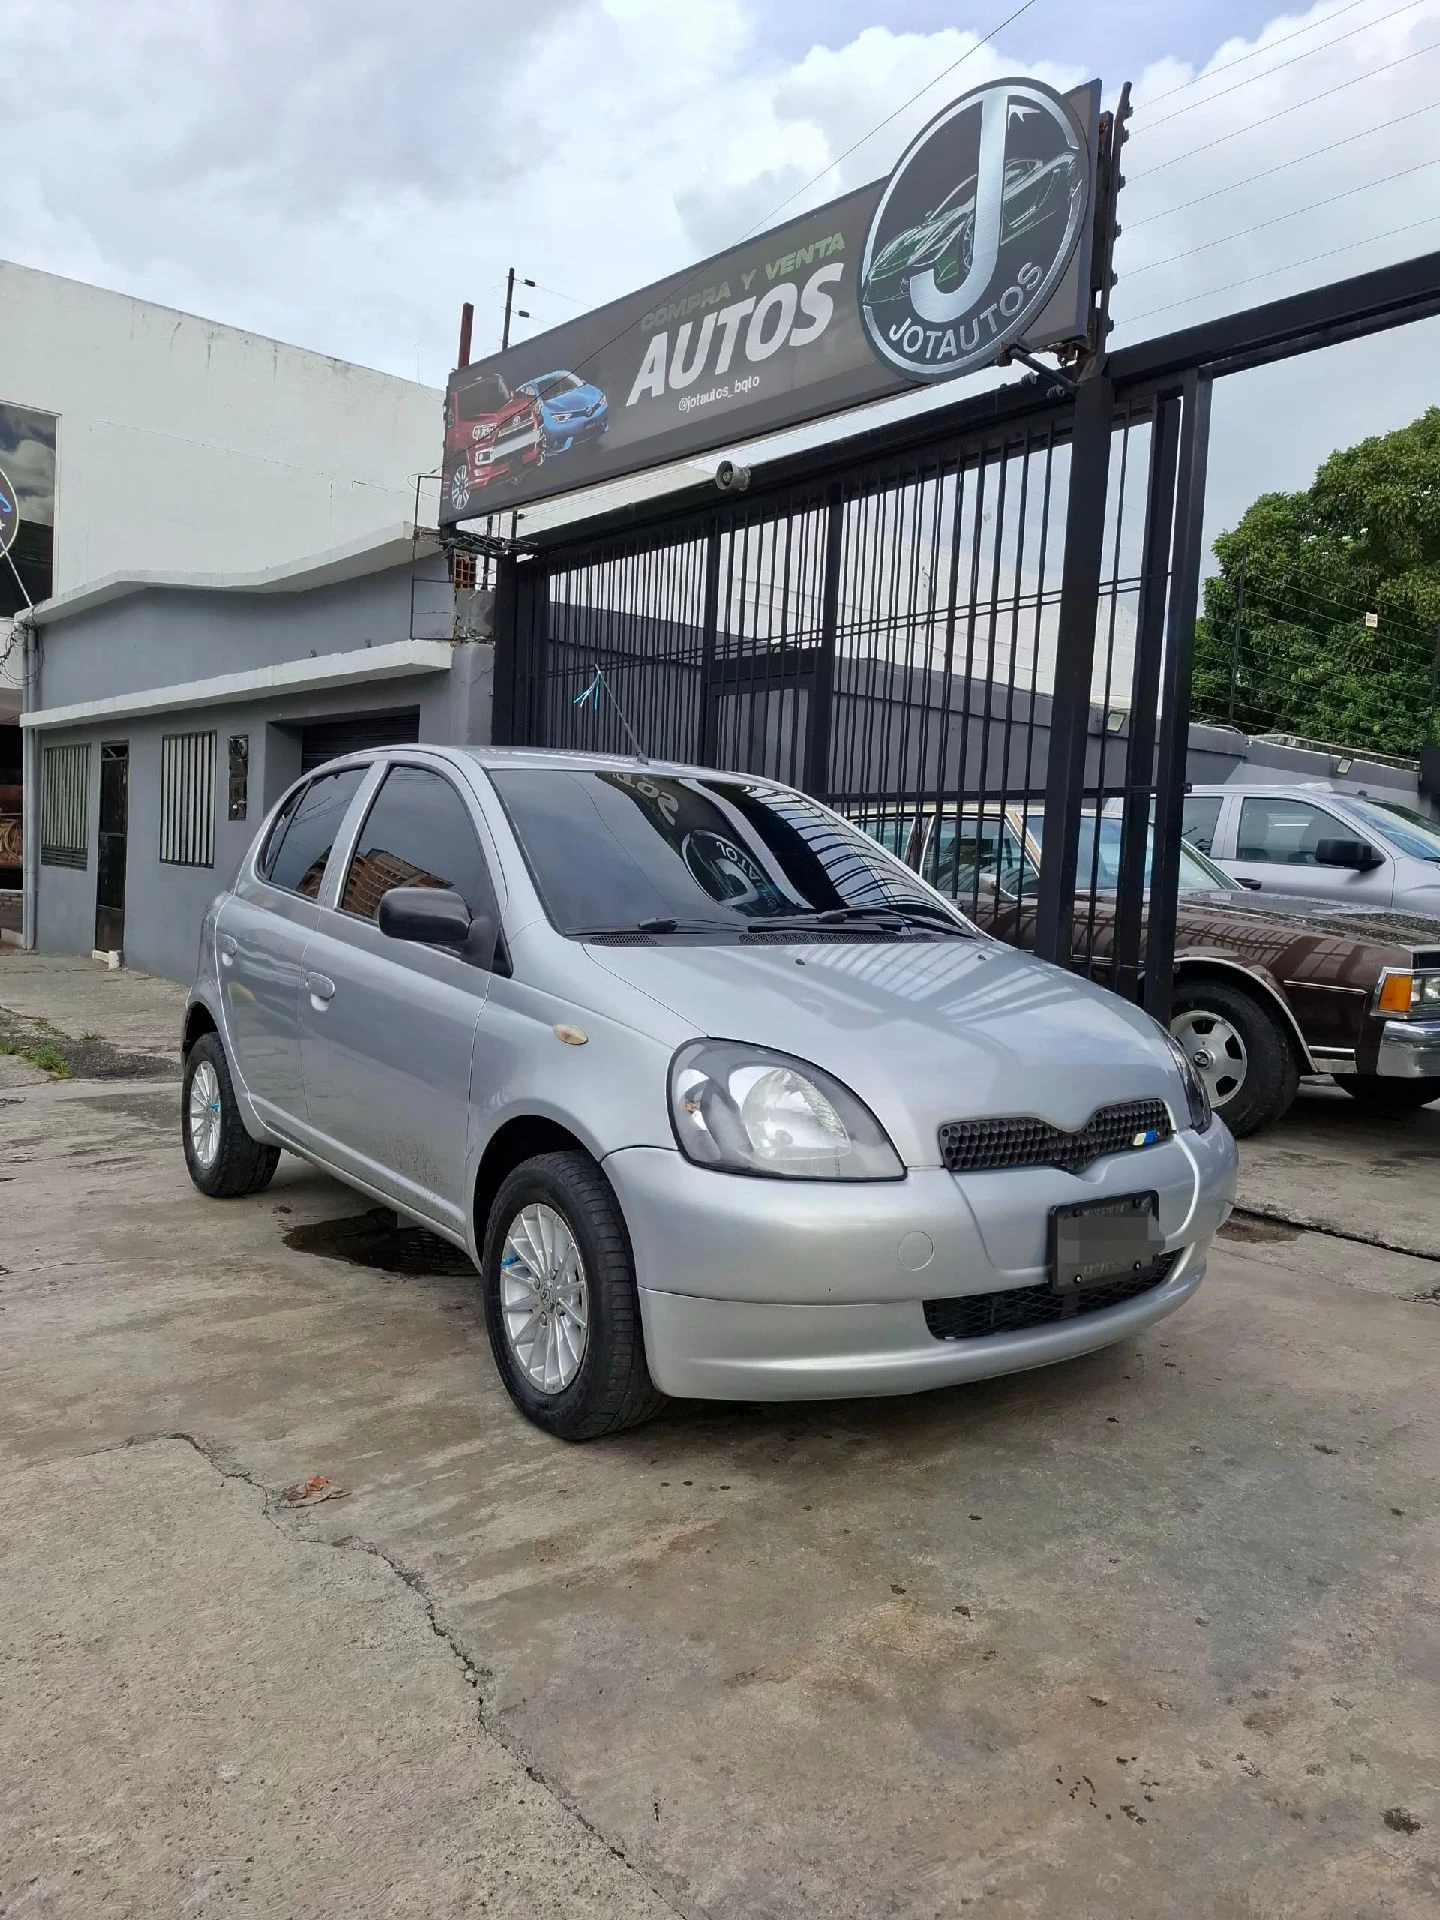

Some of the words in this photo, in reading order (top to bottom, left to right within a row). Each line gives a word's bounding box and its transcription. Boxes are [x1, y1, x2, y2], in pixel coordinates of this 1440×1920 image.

[910, 90, 1008, 323] J
[626, 262, 844, 407] AUTOS
[641, 281, 731, 332] COMPRA
[740, 268, 758, 290] Y
[765, 232, 845, 280] VENTA
[889, 262, 1043, 359] JOTAUTOS
